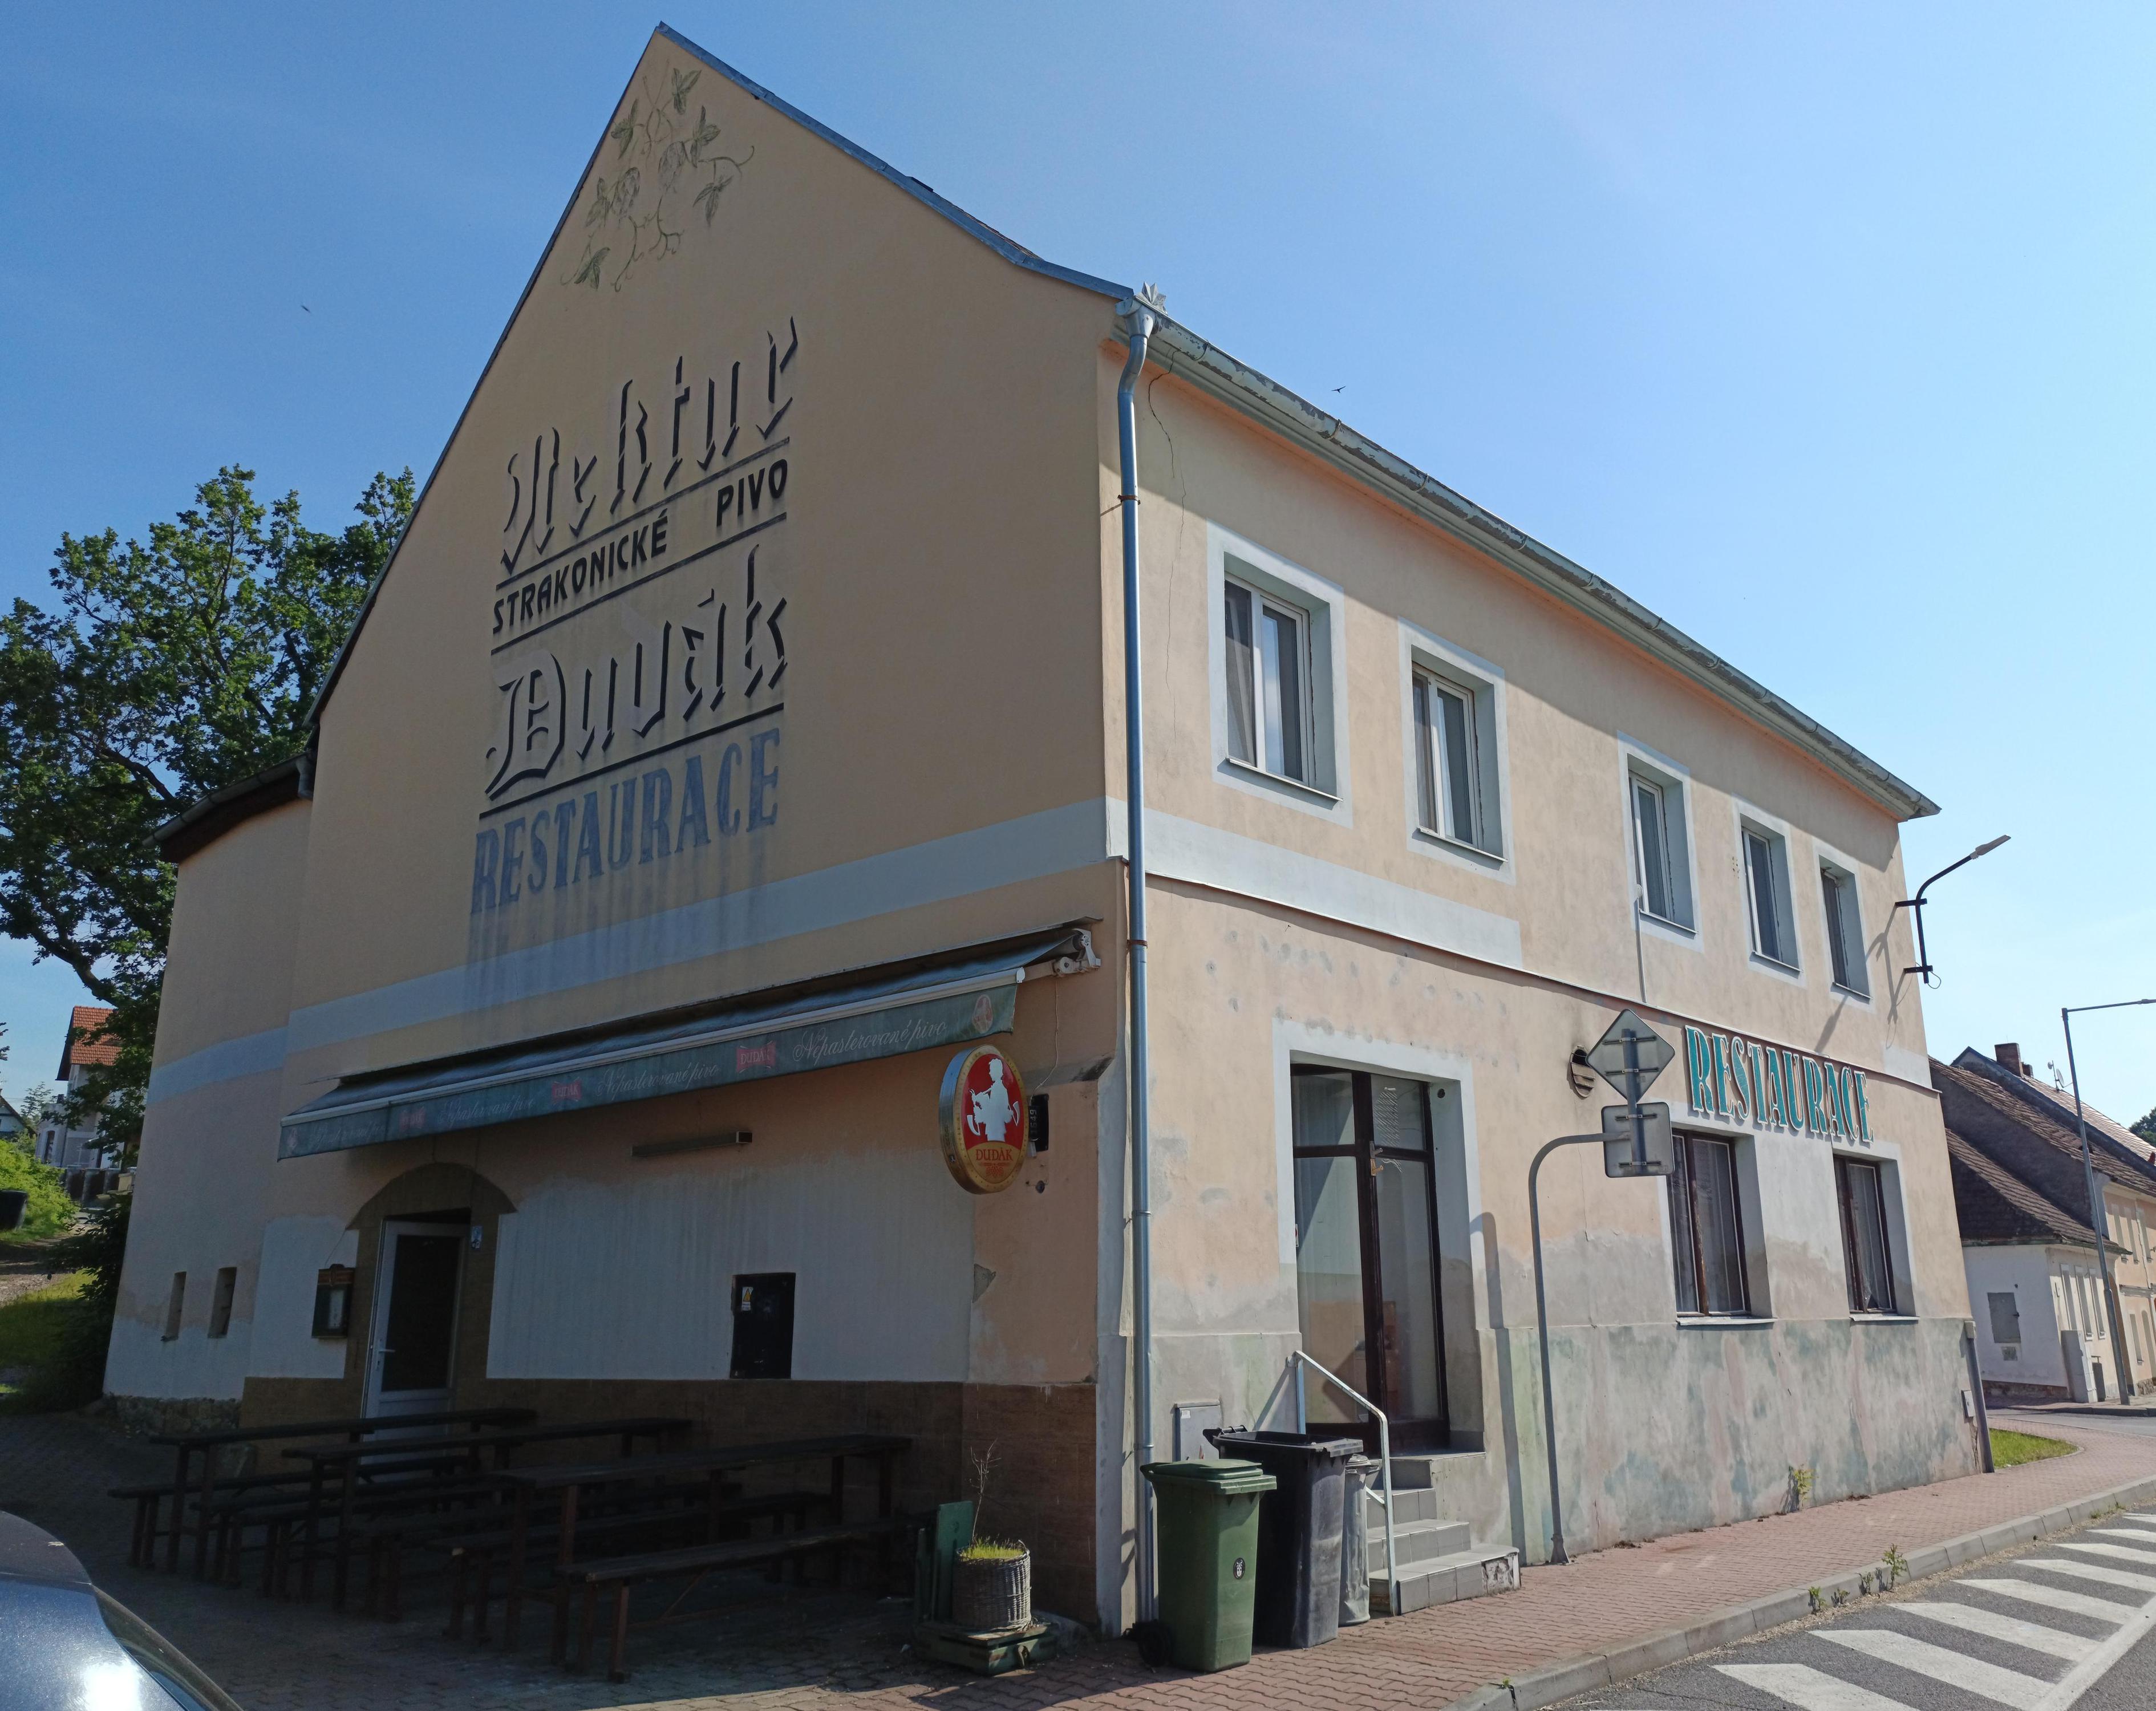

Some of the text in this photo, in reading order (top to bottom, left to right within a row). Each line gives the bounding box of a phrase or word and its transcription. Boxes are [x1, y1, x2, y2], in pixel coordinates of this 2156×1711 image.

[492, 459, 788, 634] STRAKONICKÉ PIVO
[484, 544, 788, 801] Dudák
[471, 727, 780, 914] RESTAURACE
[905, 1019, 947, 1050] pivo
[1685, 1025, 1874, 1143] RESTAURACE
